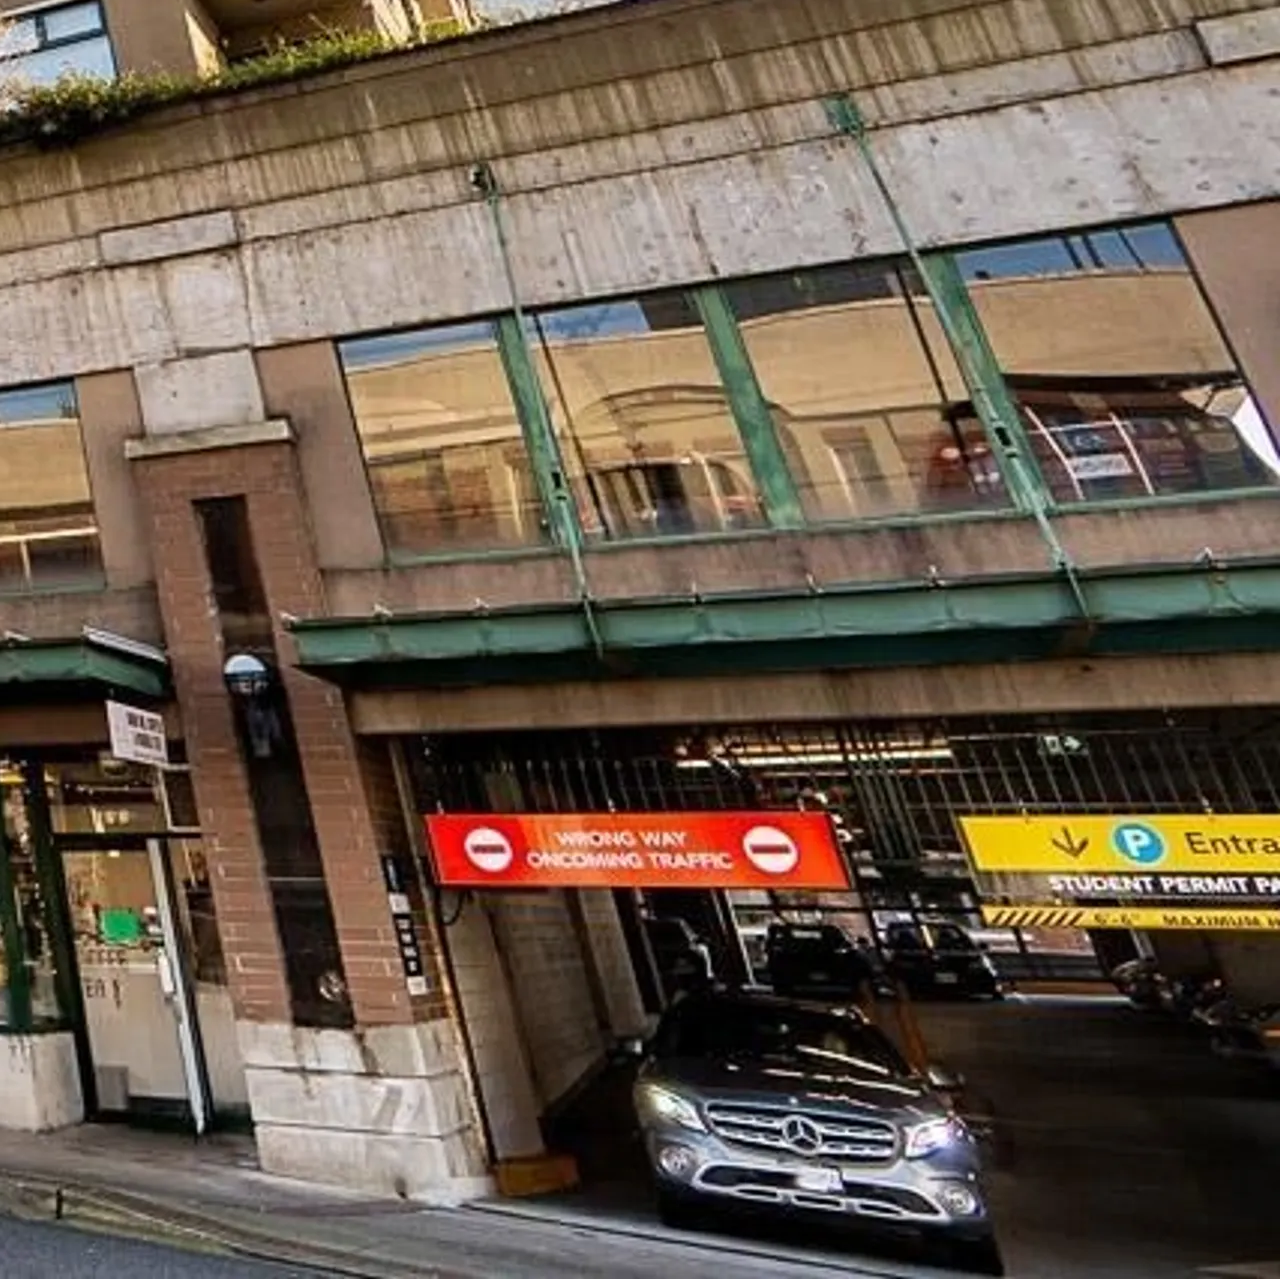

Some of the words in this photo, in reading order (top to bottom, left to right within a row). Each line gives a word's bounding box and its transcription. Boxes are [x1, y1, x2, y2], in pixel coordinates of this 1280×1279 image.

[556, 831, 638, 848] WRONG
[640, 831, 686, 848] WAY
[527, 850, 643, 869] ONCOMING
[648, 851, 734, 870] TRAFFIC
[1049, 875, 1155, 894] STUDENT
[1160, 876, 1249, 894] PERMIT
